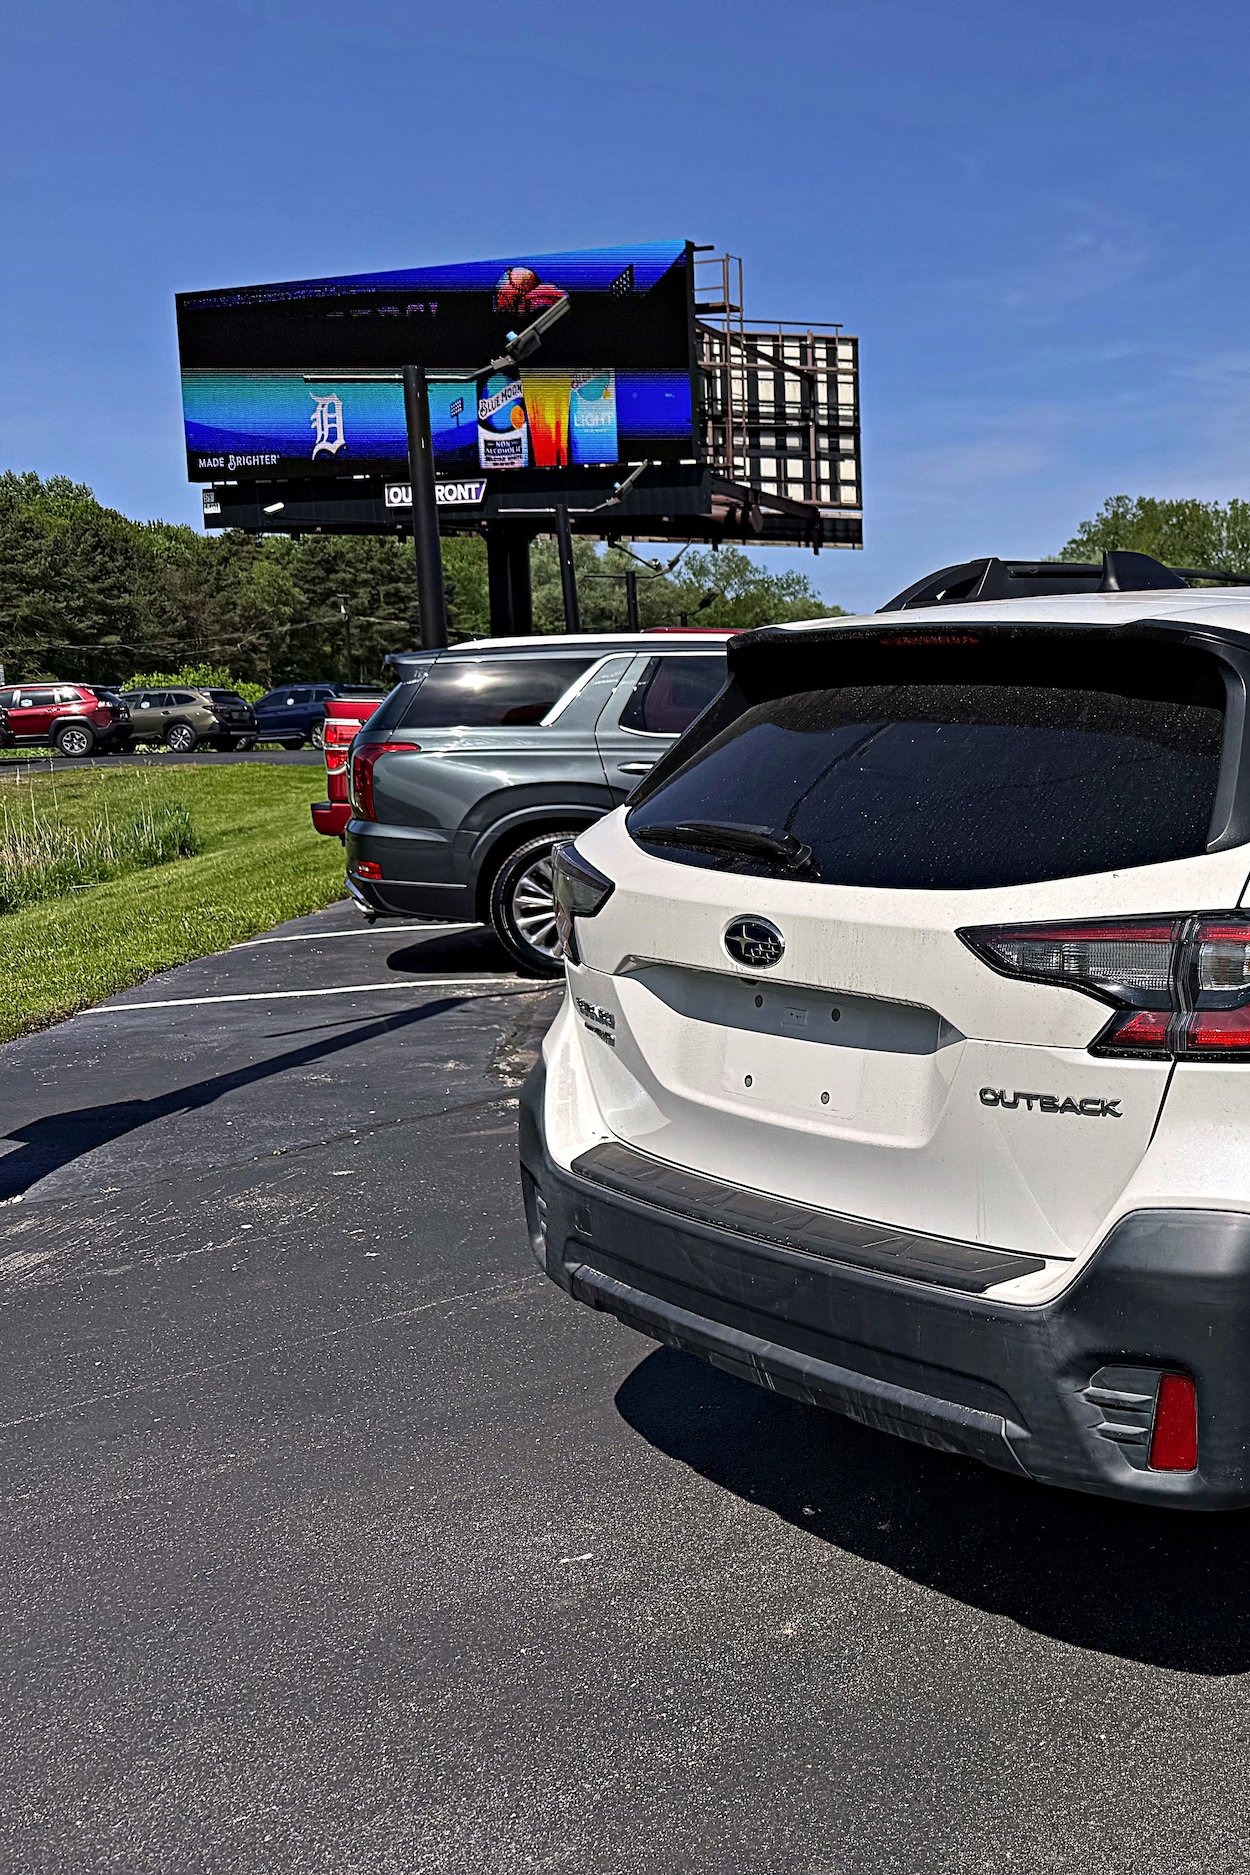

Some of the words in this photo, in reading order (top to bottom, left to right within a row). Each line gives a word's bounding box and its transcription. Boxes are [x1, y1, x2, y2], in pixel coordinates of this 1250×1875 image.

[480, 396, 501, 418] BLUE
[501, 383, 523, 402] MOON
[574, 411, 613, 427] LIGHT
[199, 457, 225, 468] MADE
[228, 454, 278, 471] BRIGHTER
[389, 483, 481, 503] OURONT
[979, 1087, 1123, 1118] OUTBACK
